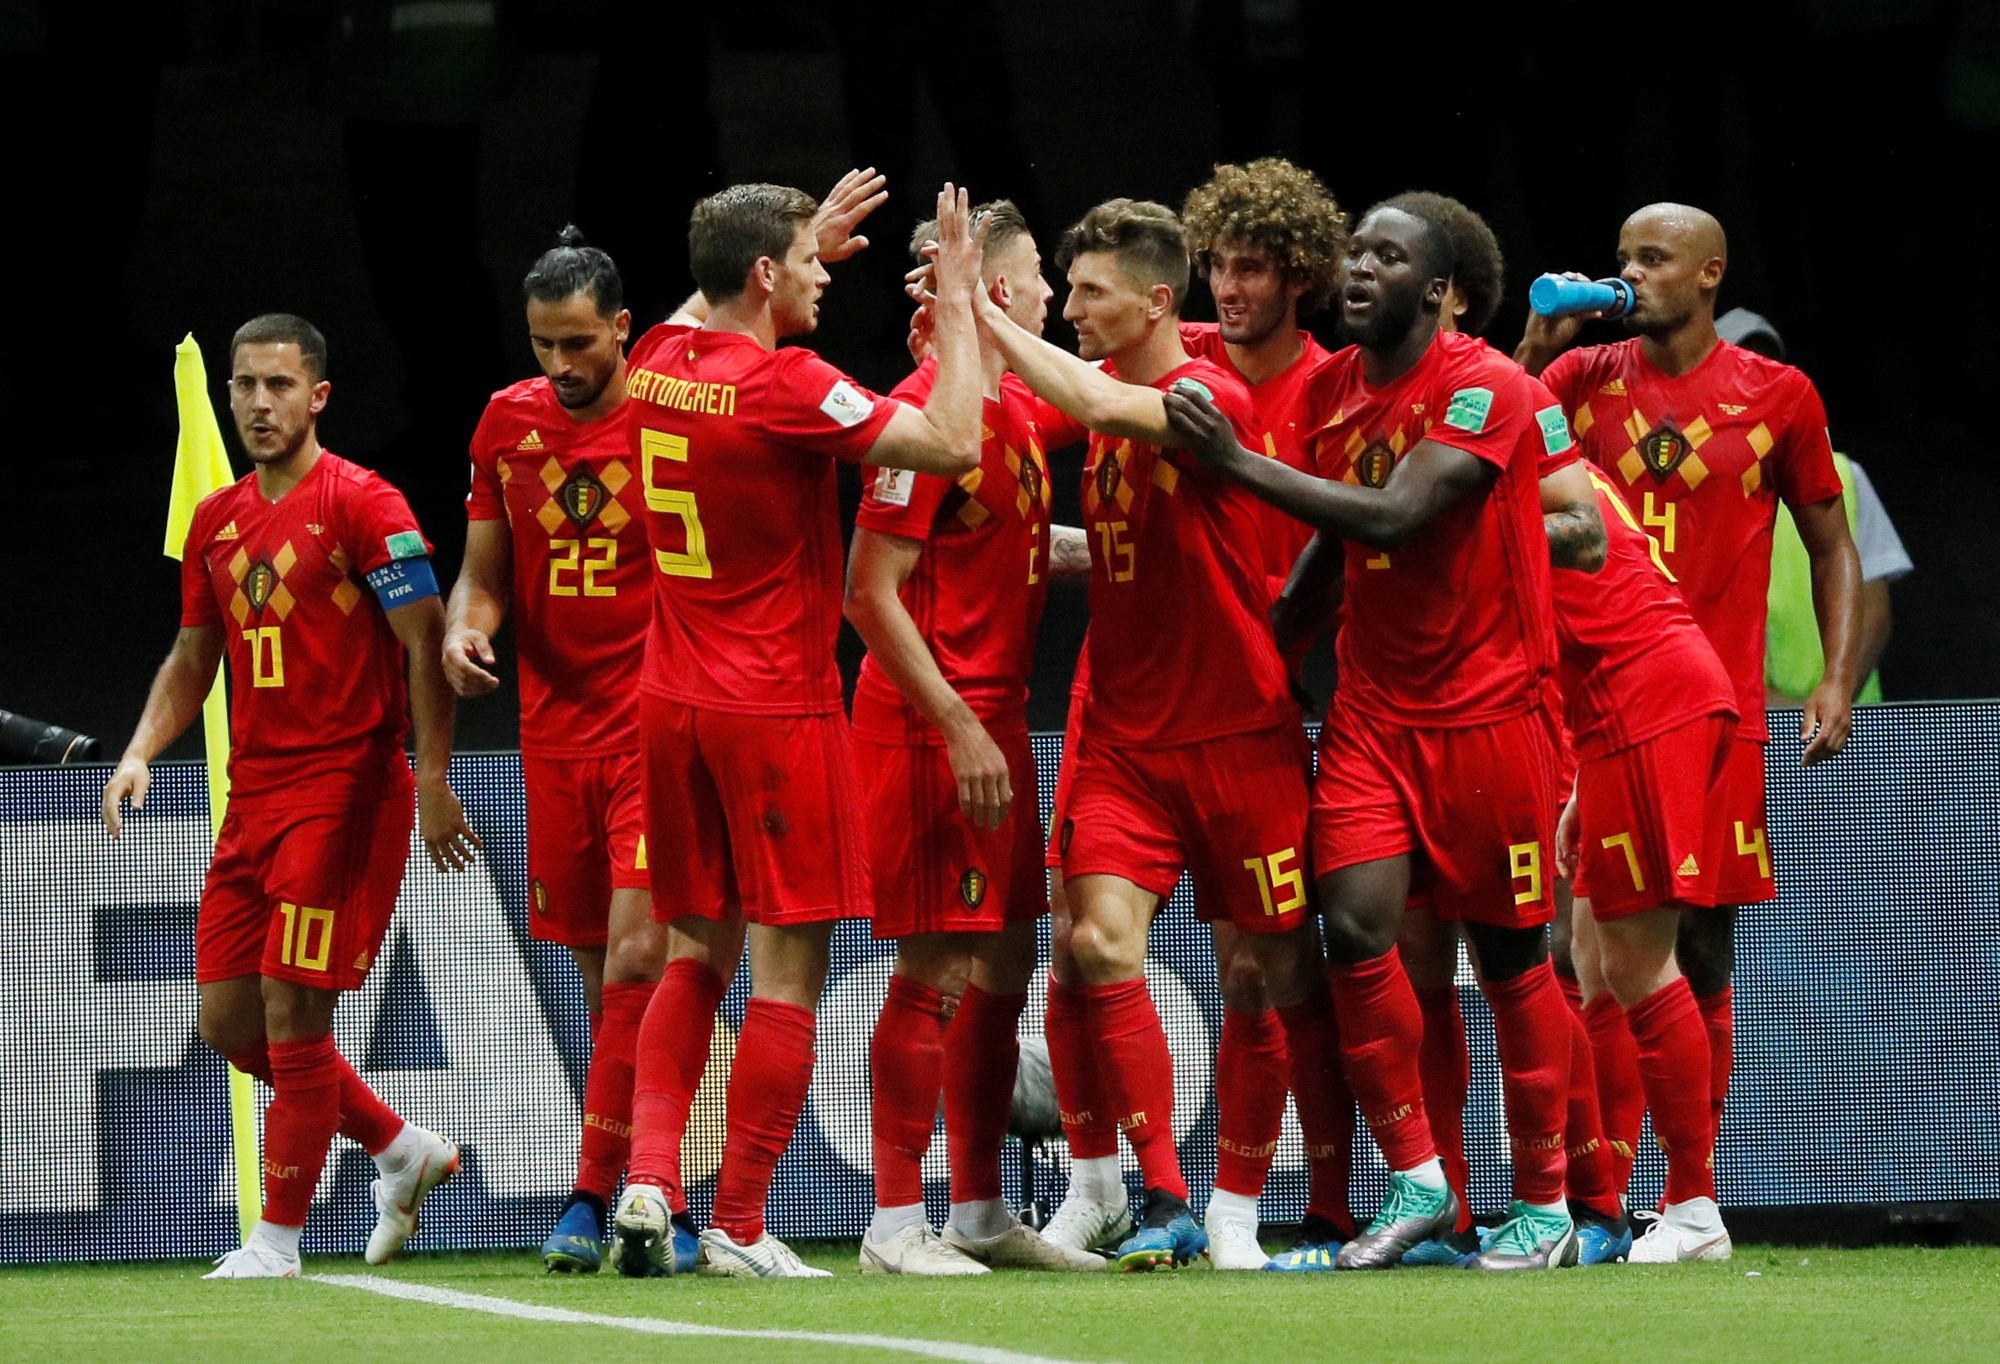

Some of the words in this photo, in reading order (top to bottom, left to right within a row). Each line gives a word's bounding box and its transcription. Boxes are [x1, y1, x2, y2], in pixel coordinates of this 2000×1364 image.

[641, 428, 712, 579] 5
[1643, 492, 1676, 553] 4
[549, 538, 617, 597] 22
[1095, 520, 1135, 582] 15
[388, 584, 414, 599] FIFA
[242, 626, 284, 688] 10
[1508, 842, 1542, 905] 9
[1602, 832, 1645, 892] 7
[1733, 821, 1771, 879] 4
[1244, 847, 1307, 916] 15
[280, 902, 335, 972] 10
